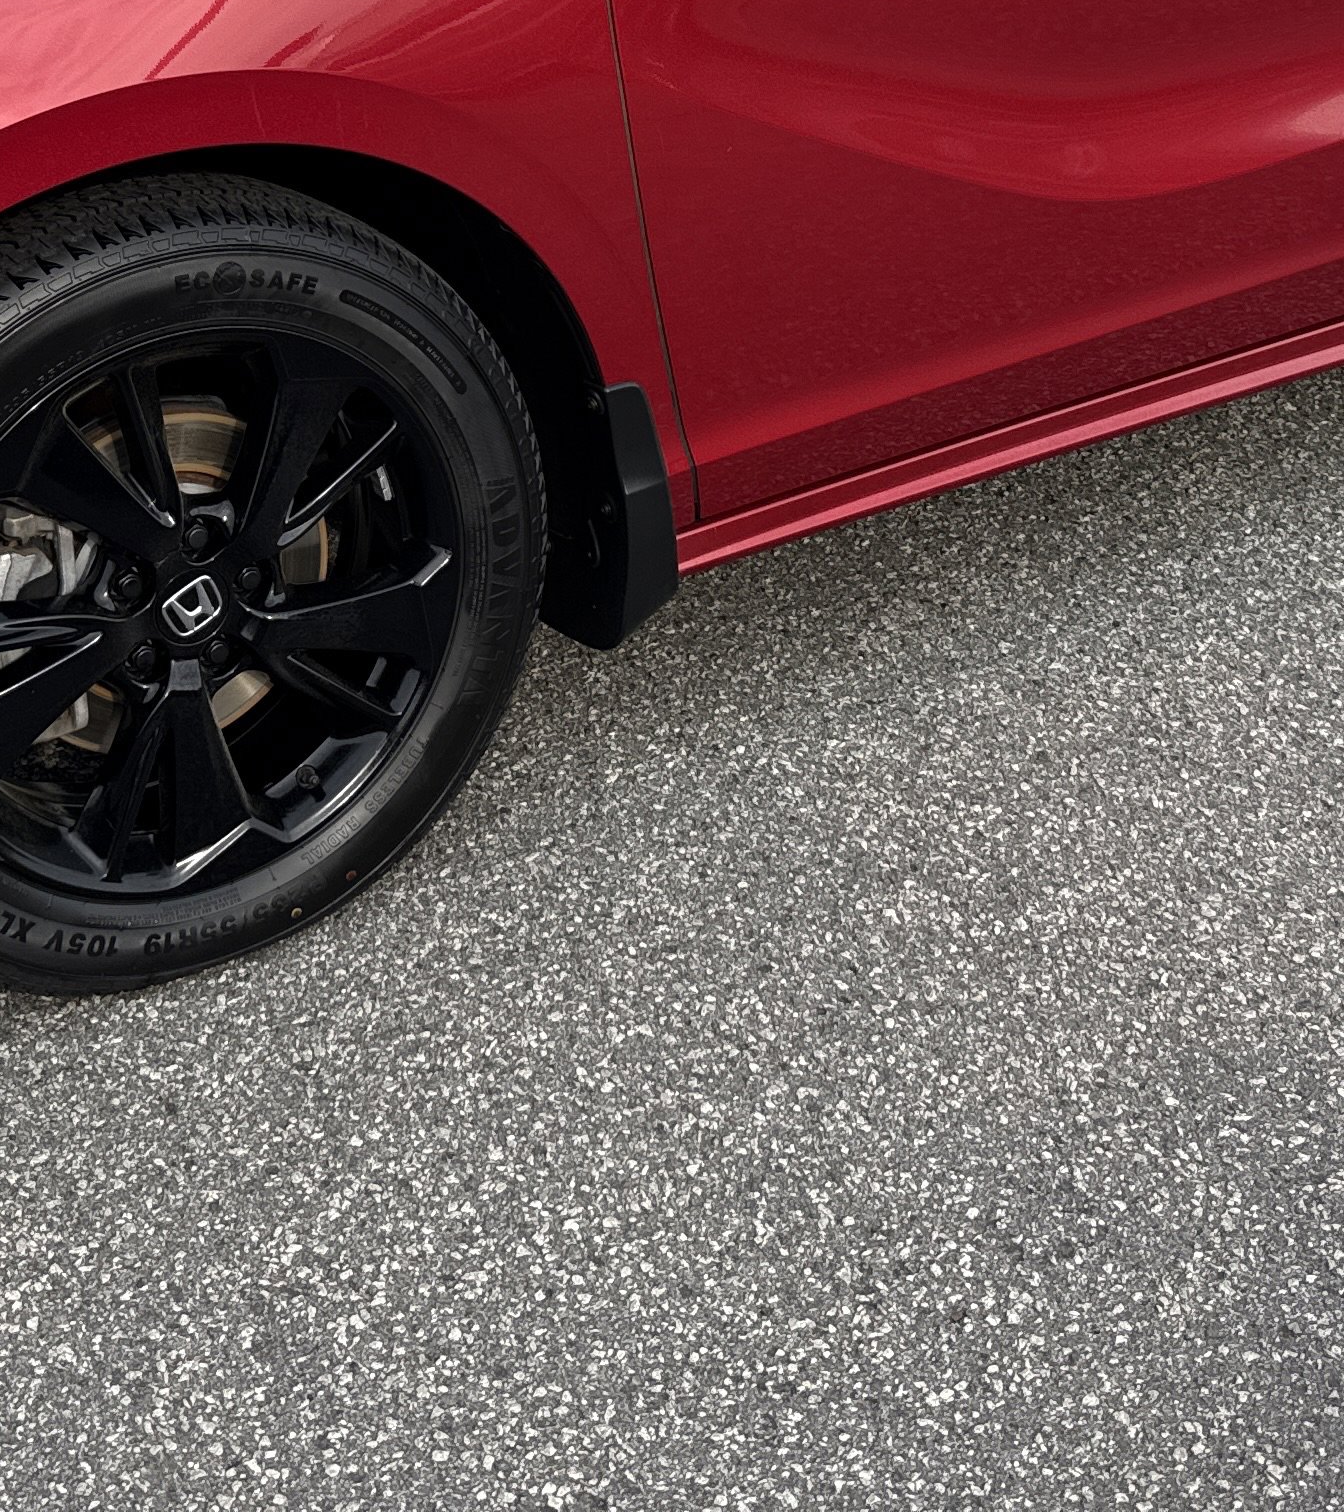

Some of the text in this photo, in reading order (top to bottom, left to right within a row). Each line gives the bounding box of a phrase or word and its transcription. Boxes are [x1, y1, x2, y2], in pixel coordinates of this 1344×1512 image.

[301, 737, 428, 865] TUBELESS RADIAL
[0, 908, 36, 943] XL
[42, 929, 119, 968] 105V
